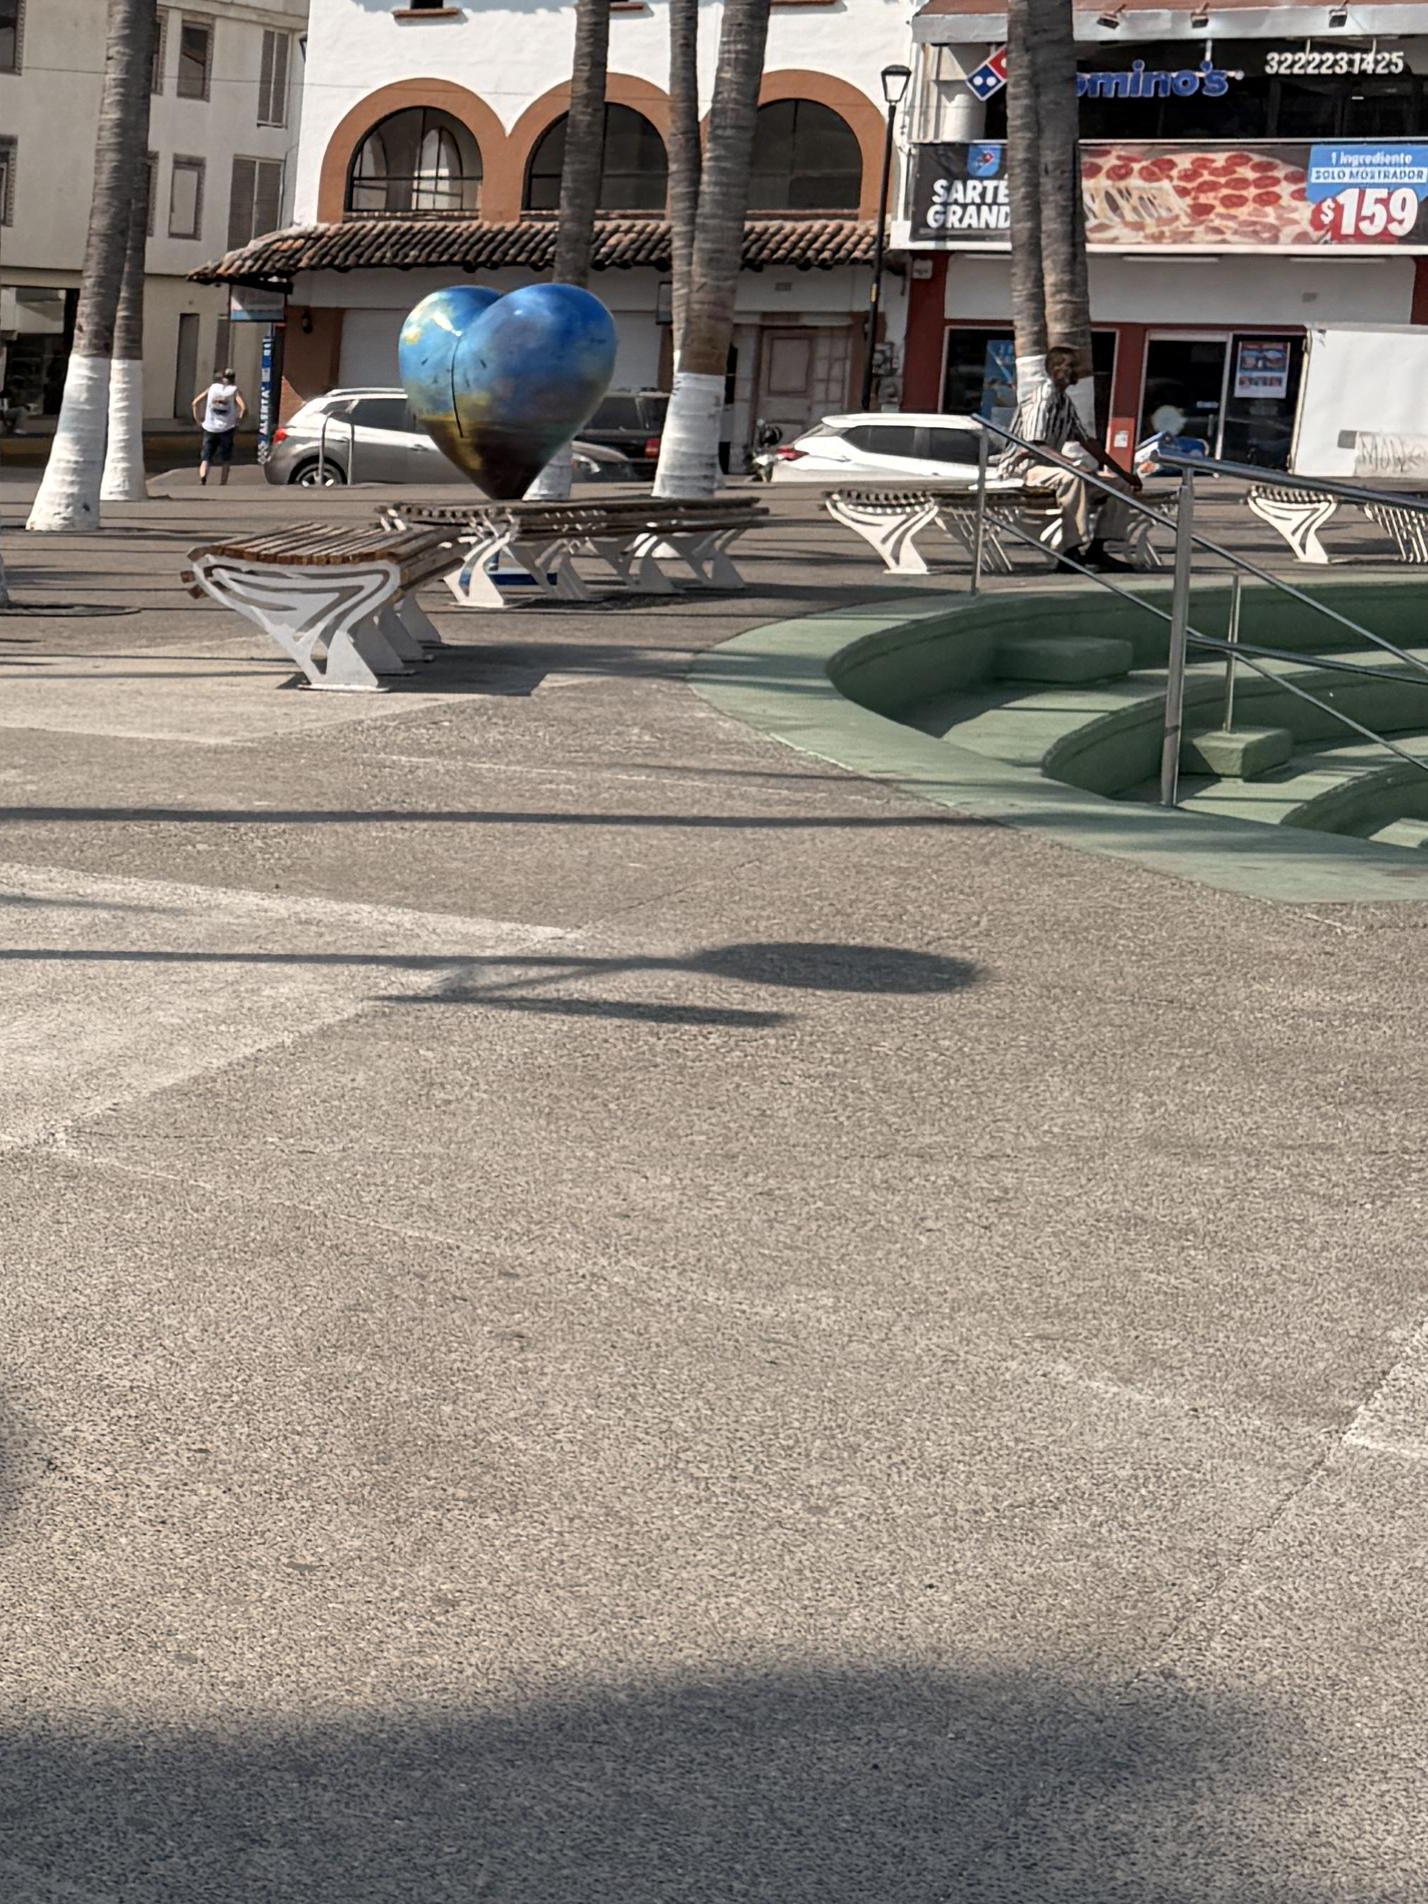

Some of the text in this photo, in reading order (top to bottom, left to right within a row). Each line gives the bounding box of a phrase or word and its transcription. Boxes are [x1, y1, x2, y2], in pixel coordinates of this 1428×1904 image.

[1264, 51, 1404, 75] 3222231425
[1340, 151, 1412, 167] ingrediente
[1314, 170, 1424, 180] SOLO MOSTRADOR
